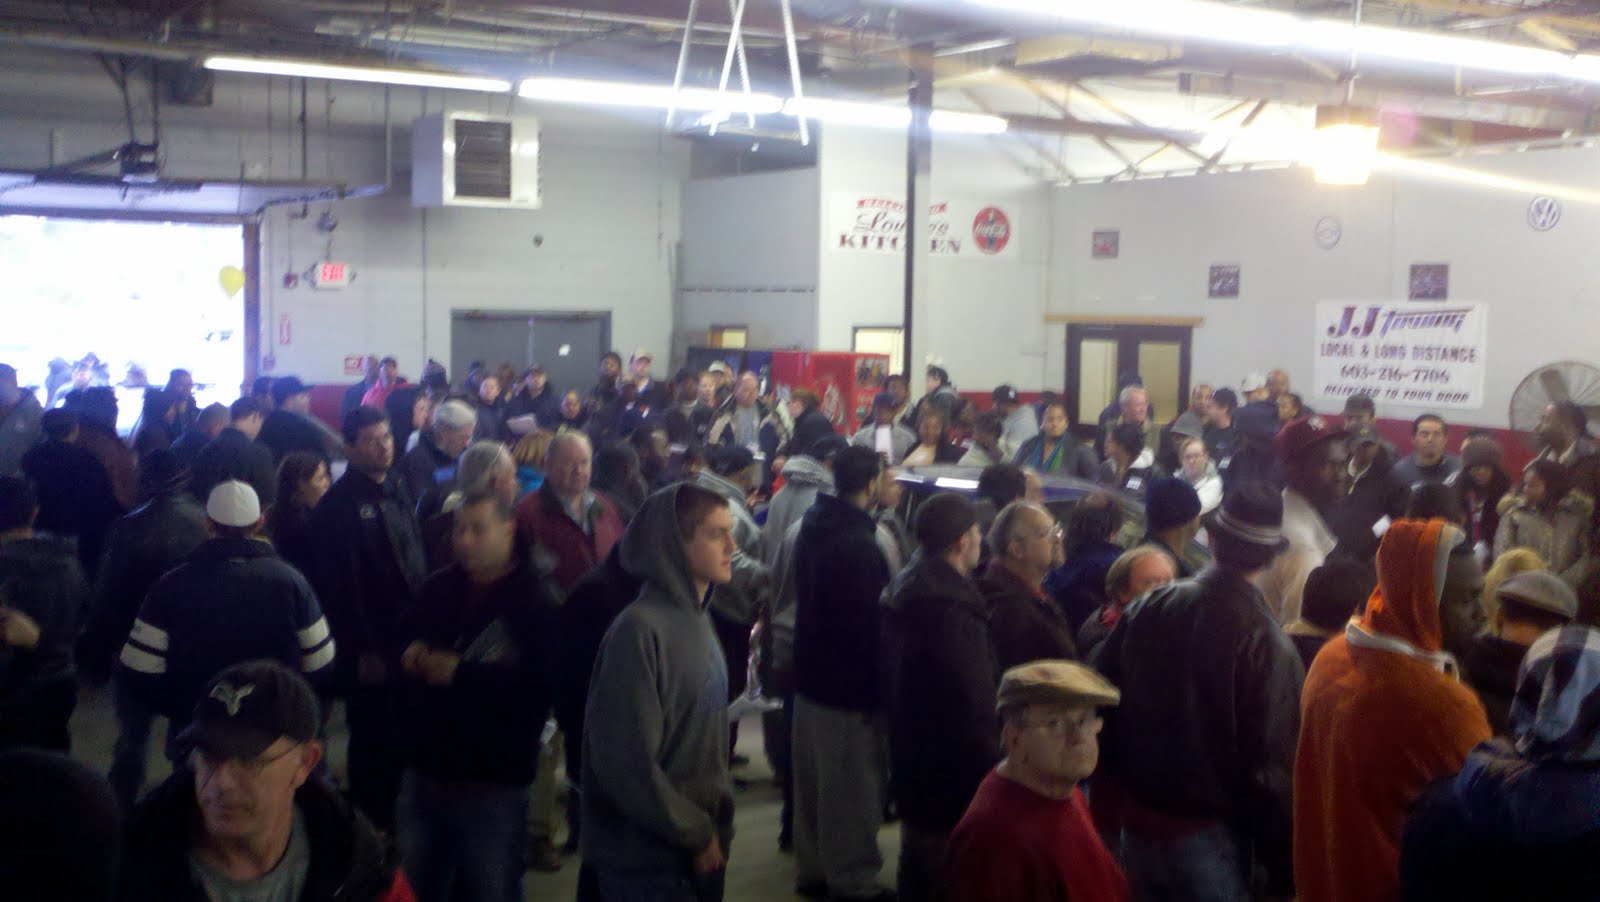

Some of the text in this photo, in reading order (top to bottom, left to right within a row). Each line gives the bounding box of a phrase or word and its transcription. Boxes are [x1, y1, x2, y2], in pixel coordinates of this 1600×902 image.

[839, 235, 961, 253] KITCEN
[321, 263, 345, 281] EXIT
[1321, 343, 1477, 363] LOCAL & LONG DISTANCE
[1385, 388, 1399, 399] TO
[1403, 389, 1433, 401] YOUR
[1436, 390, 1470, 403] DOOR
